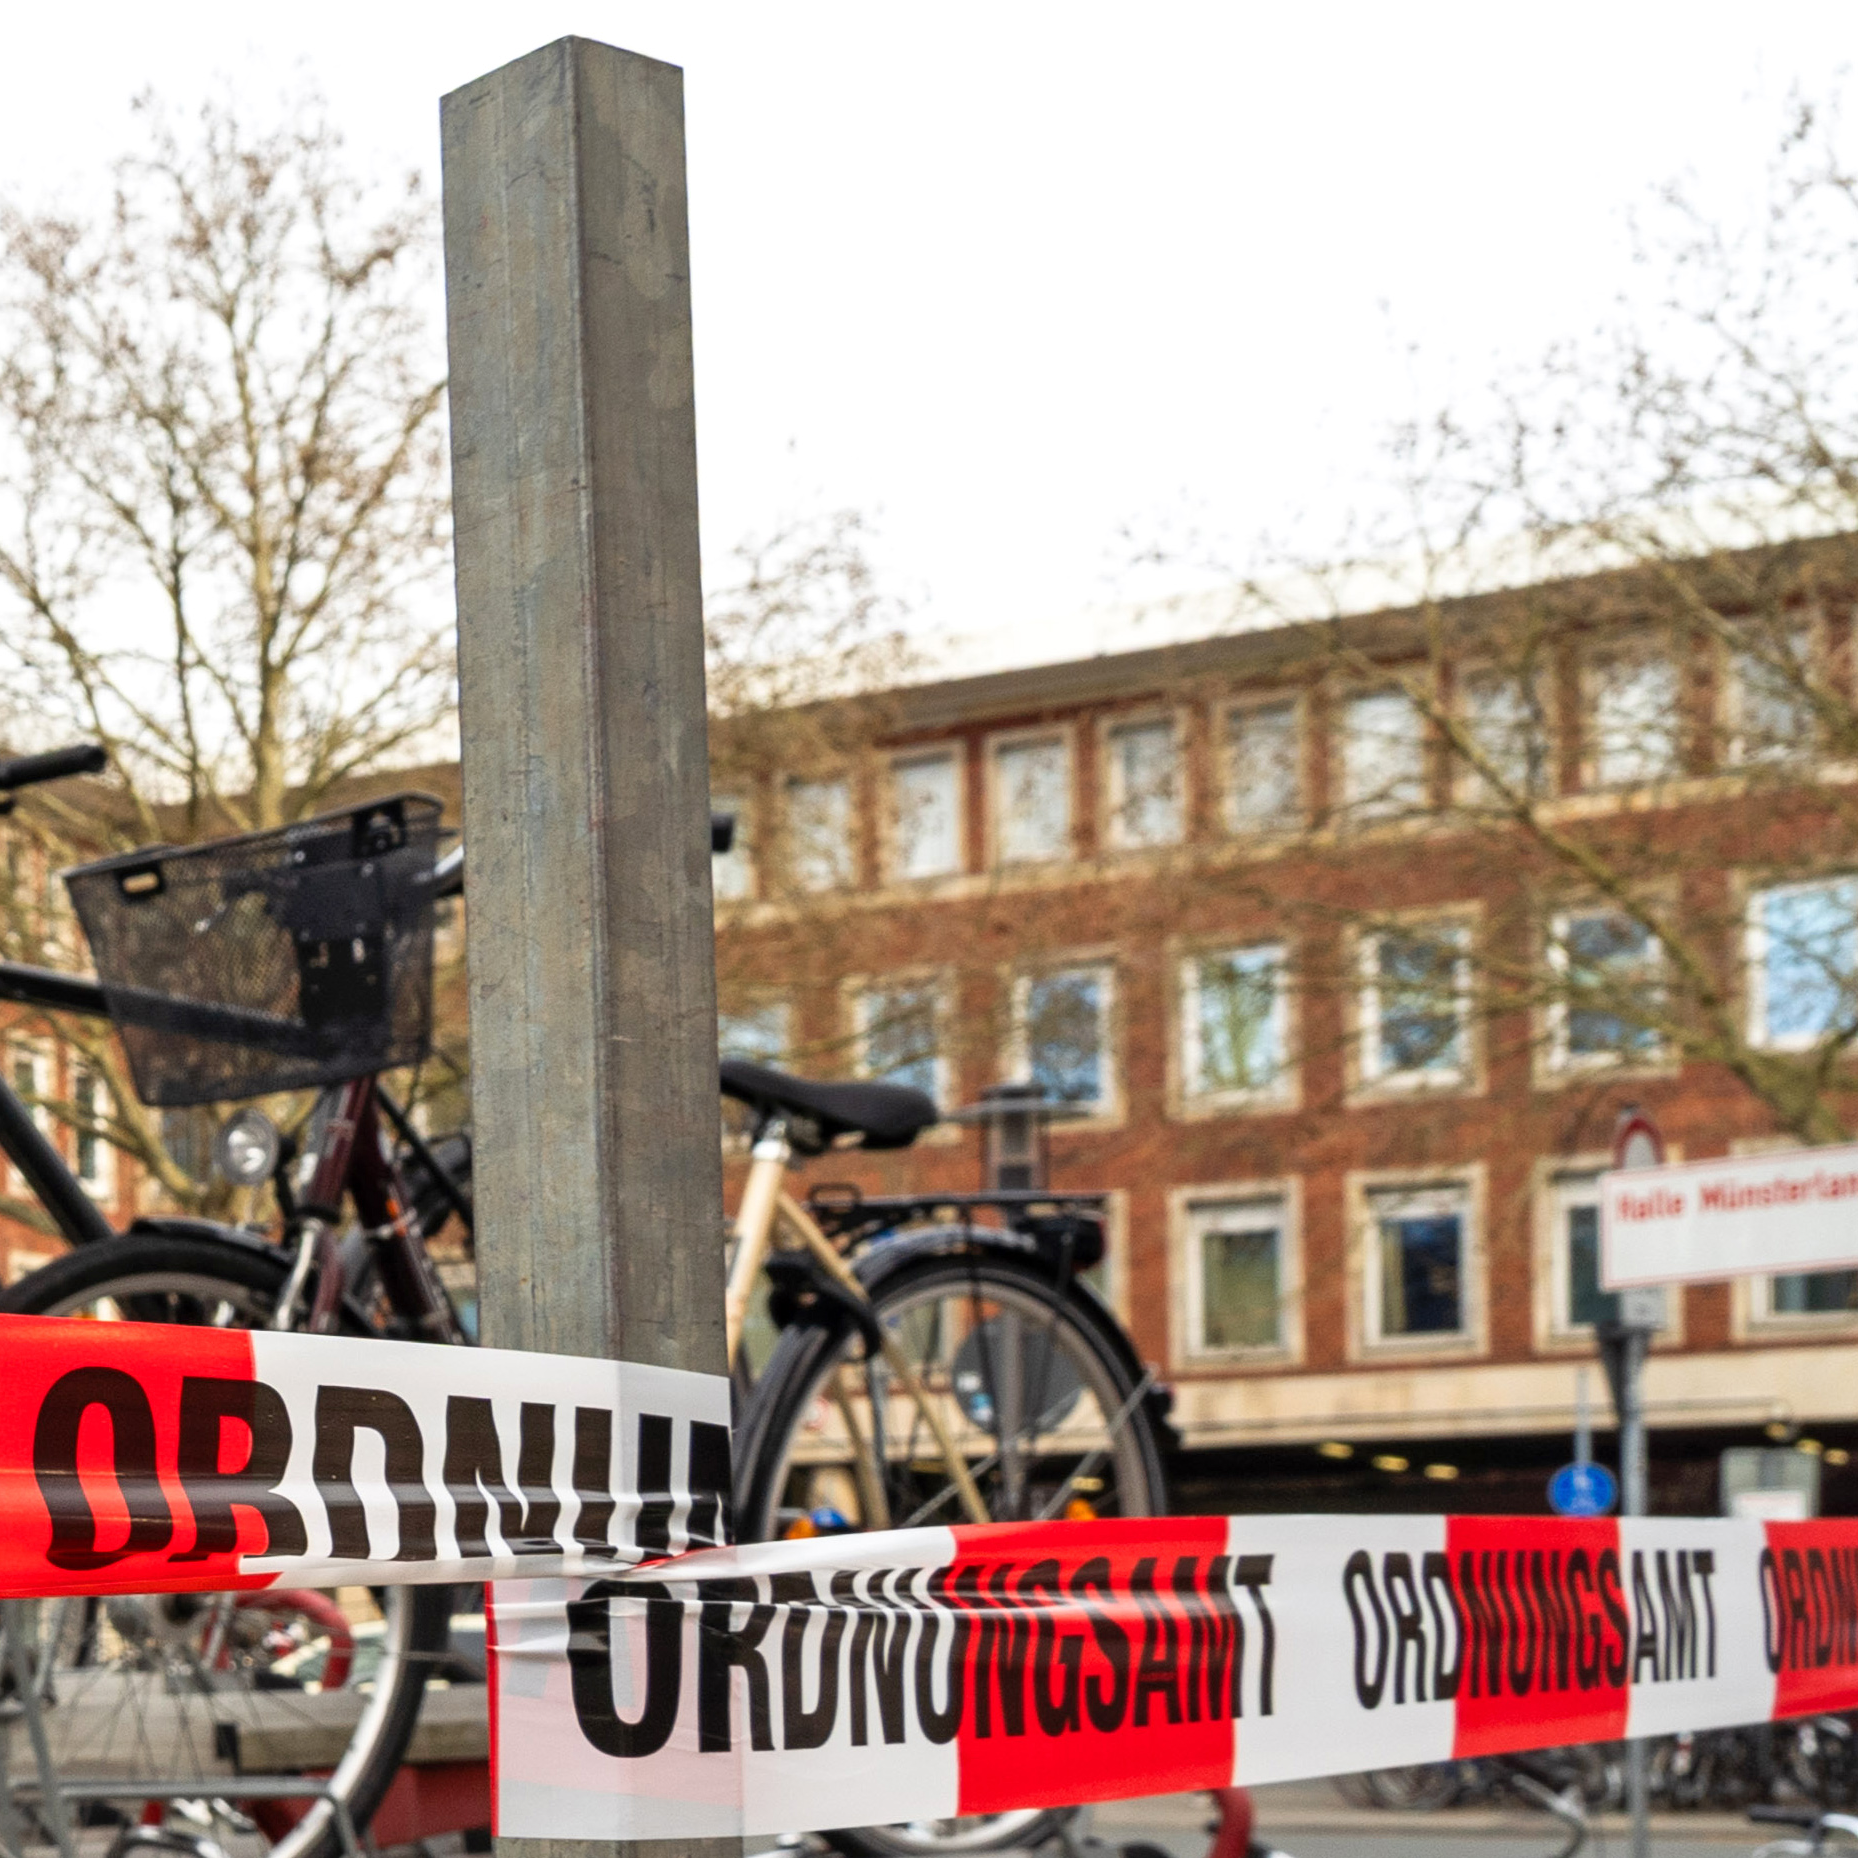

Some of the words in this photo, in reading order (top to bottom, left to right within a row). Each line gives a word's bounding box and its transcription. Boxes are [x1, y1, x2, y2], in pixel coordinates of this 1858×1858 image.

[567, 1554, 1277, 1758] ORDNUNGSAMT
[1341, 1547, 1718, 1711] ORDNUNGSAMT
[1758, 1547, 1858, 1675] ORDN
